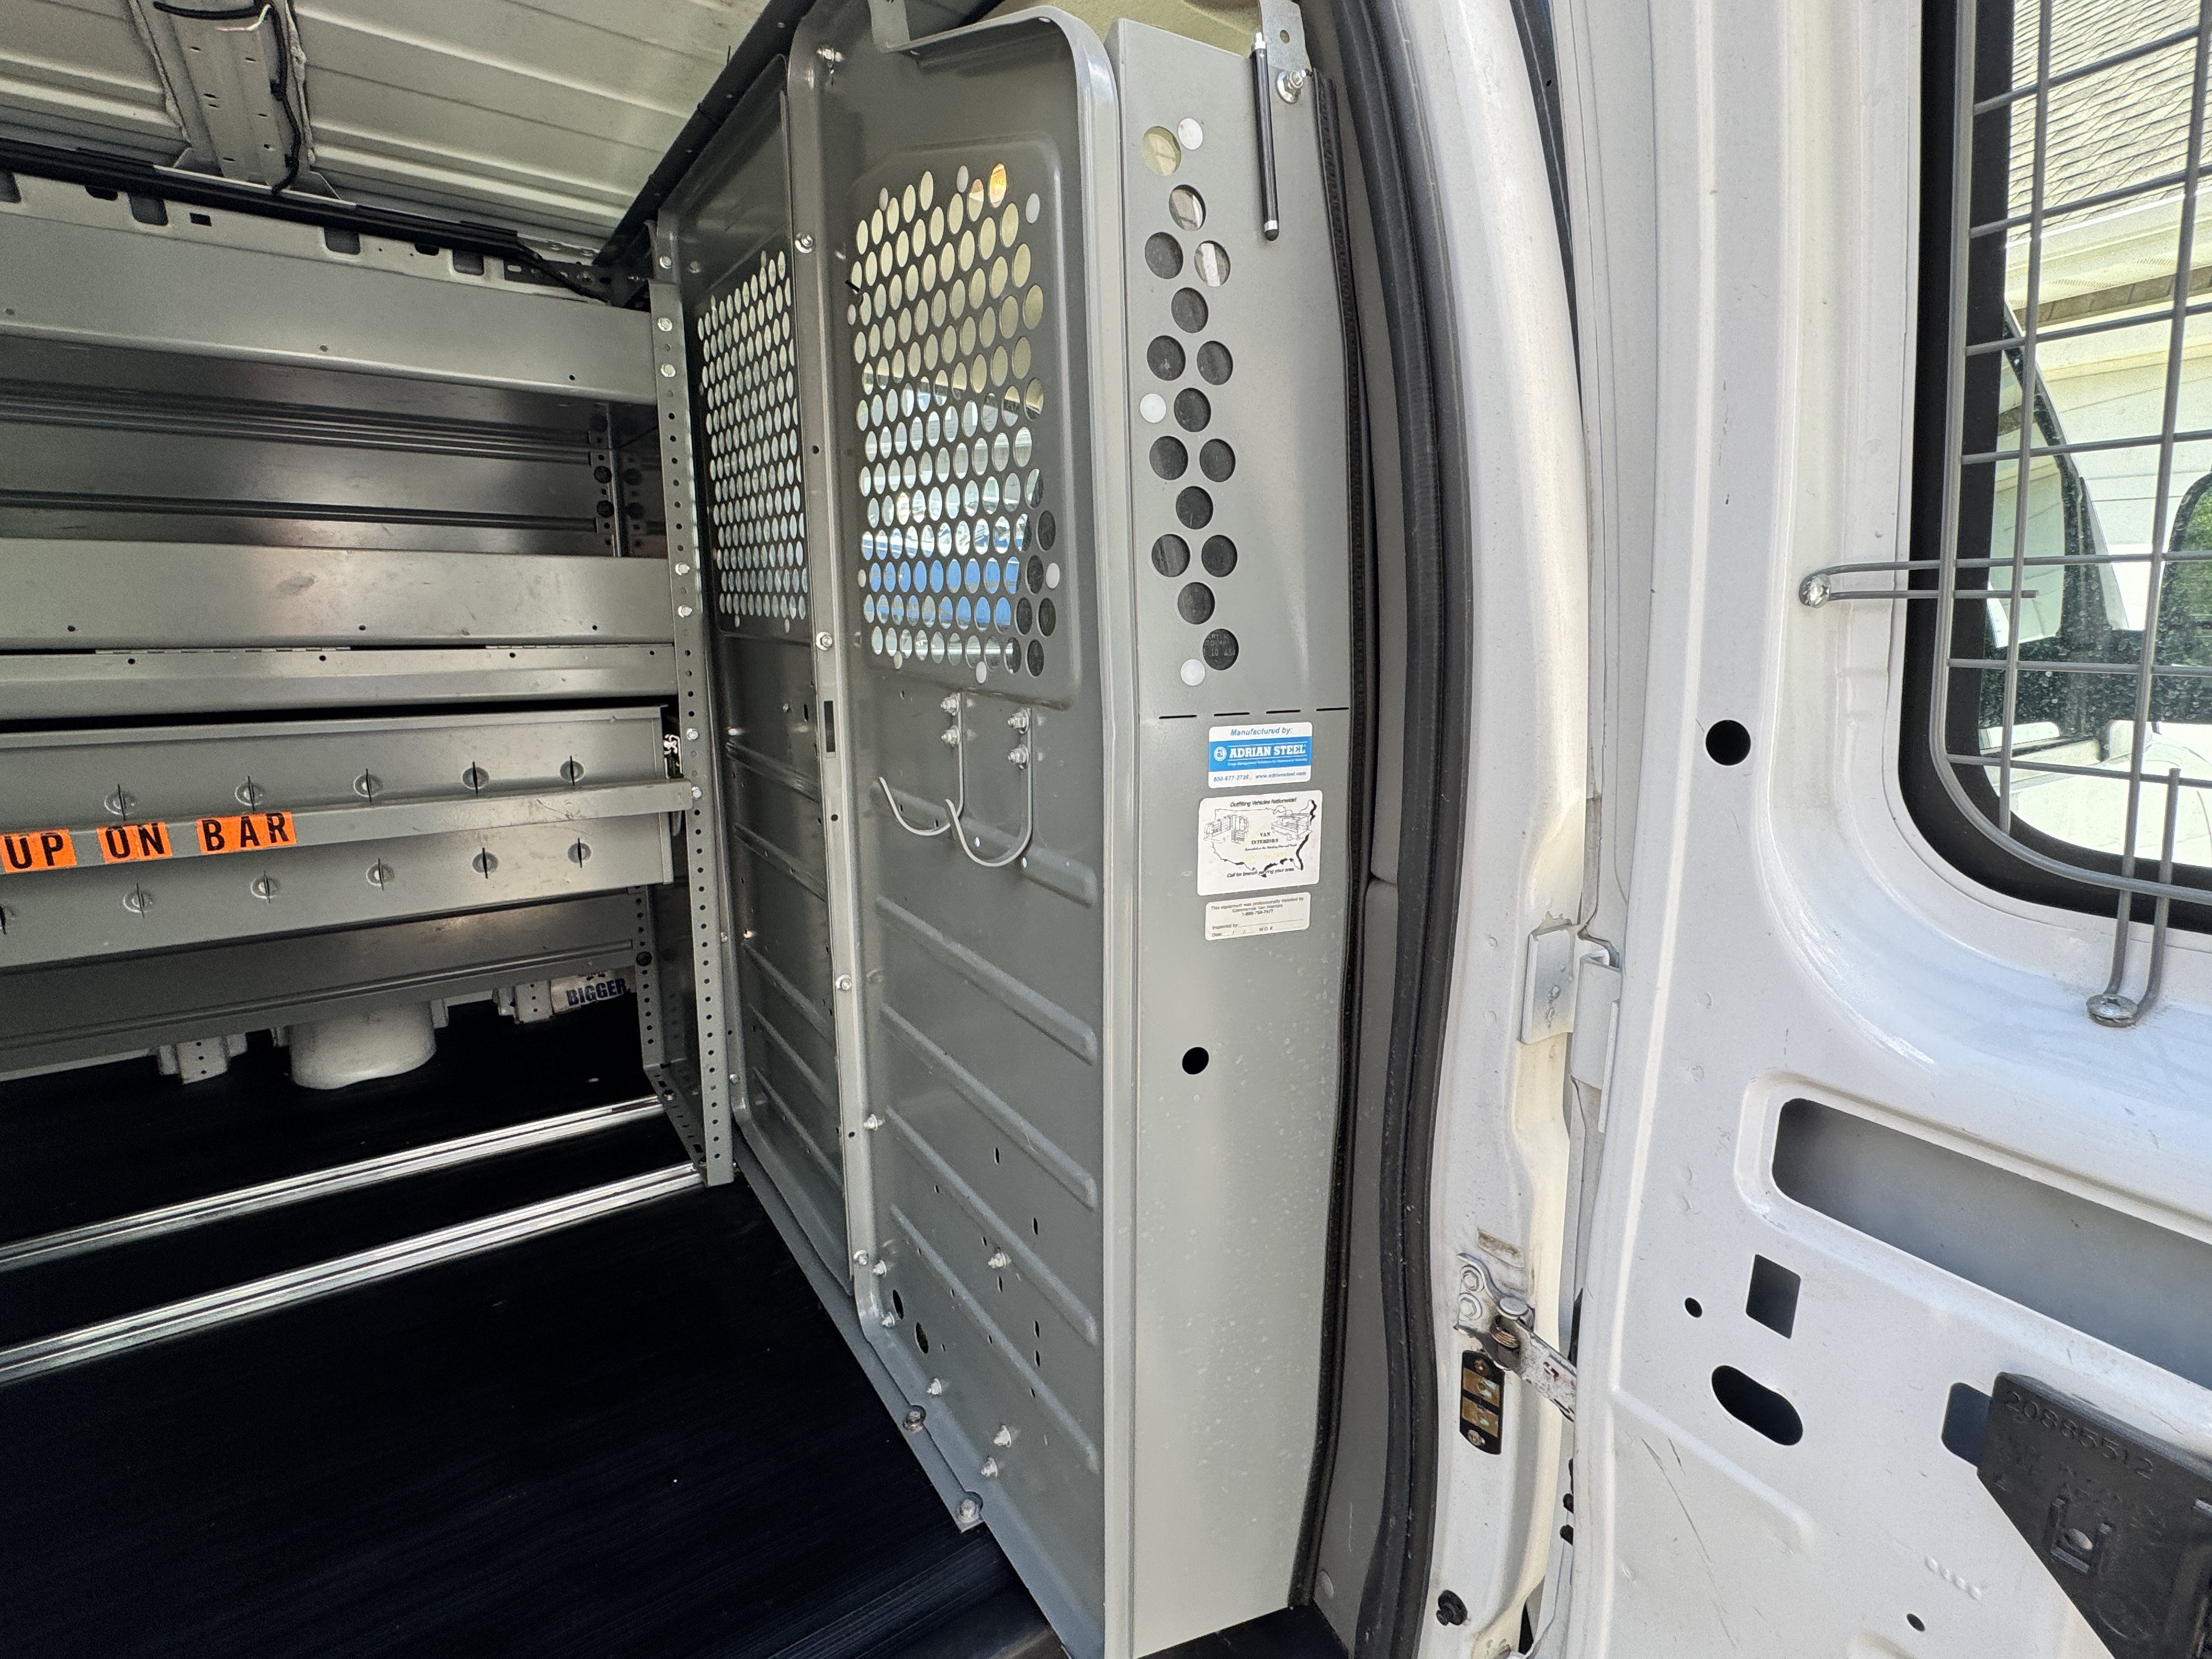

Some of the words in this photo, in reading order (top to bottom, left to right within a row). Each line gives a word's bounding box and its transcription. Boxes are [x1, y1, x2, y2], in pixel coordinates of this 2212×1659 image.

[1230, 727, 1280, 736] Manufactured
[1282, 727, 1293, 736] by:
[1229, 746, 1271, 758] ADRIAN
[1273, 744, 1306, 756] STEEL
[4, 832, 65, 869] UP
[105, 822, 165, 859] ON
[201, 812, 289, 853] BAR
